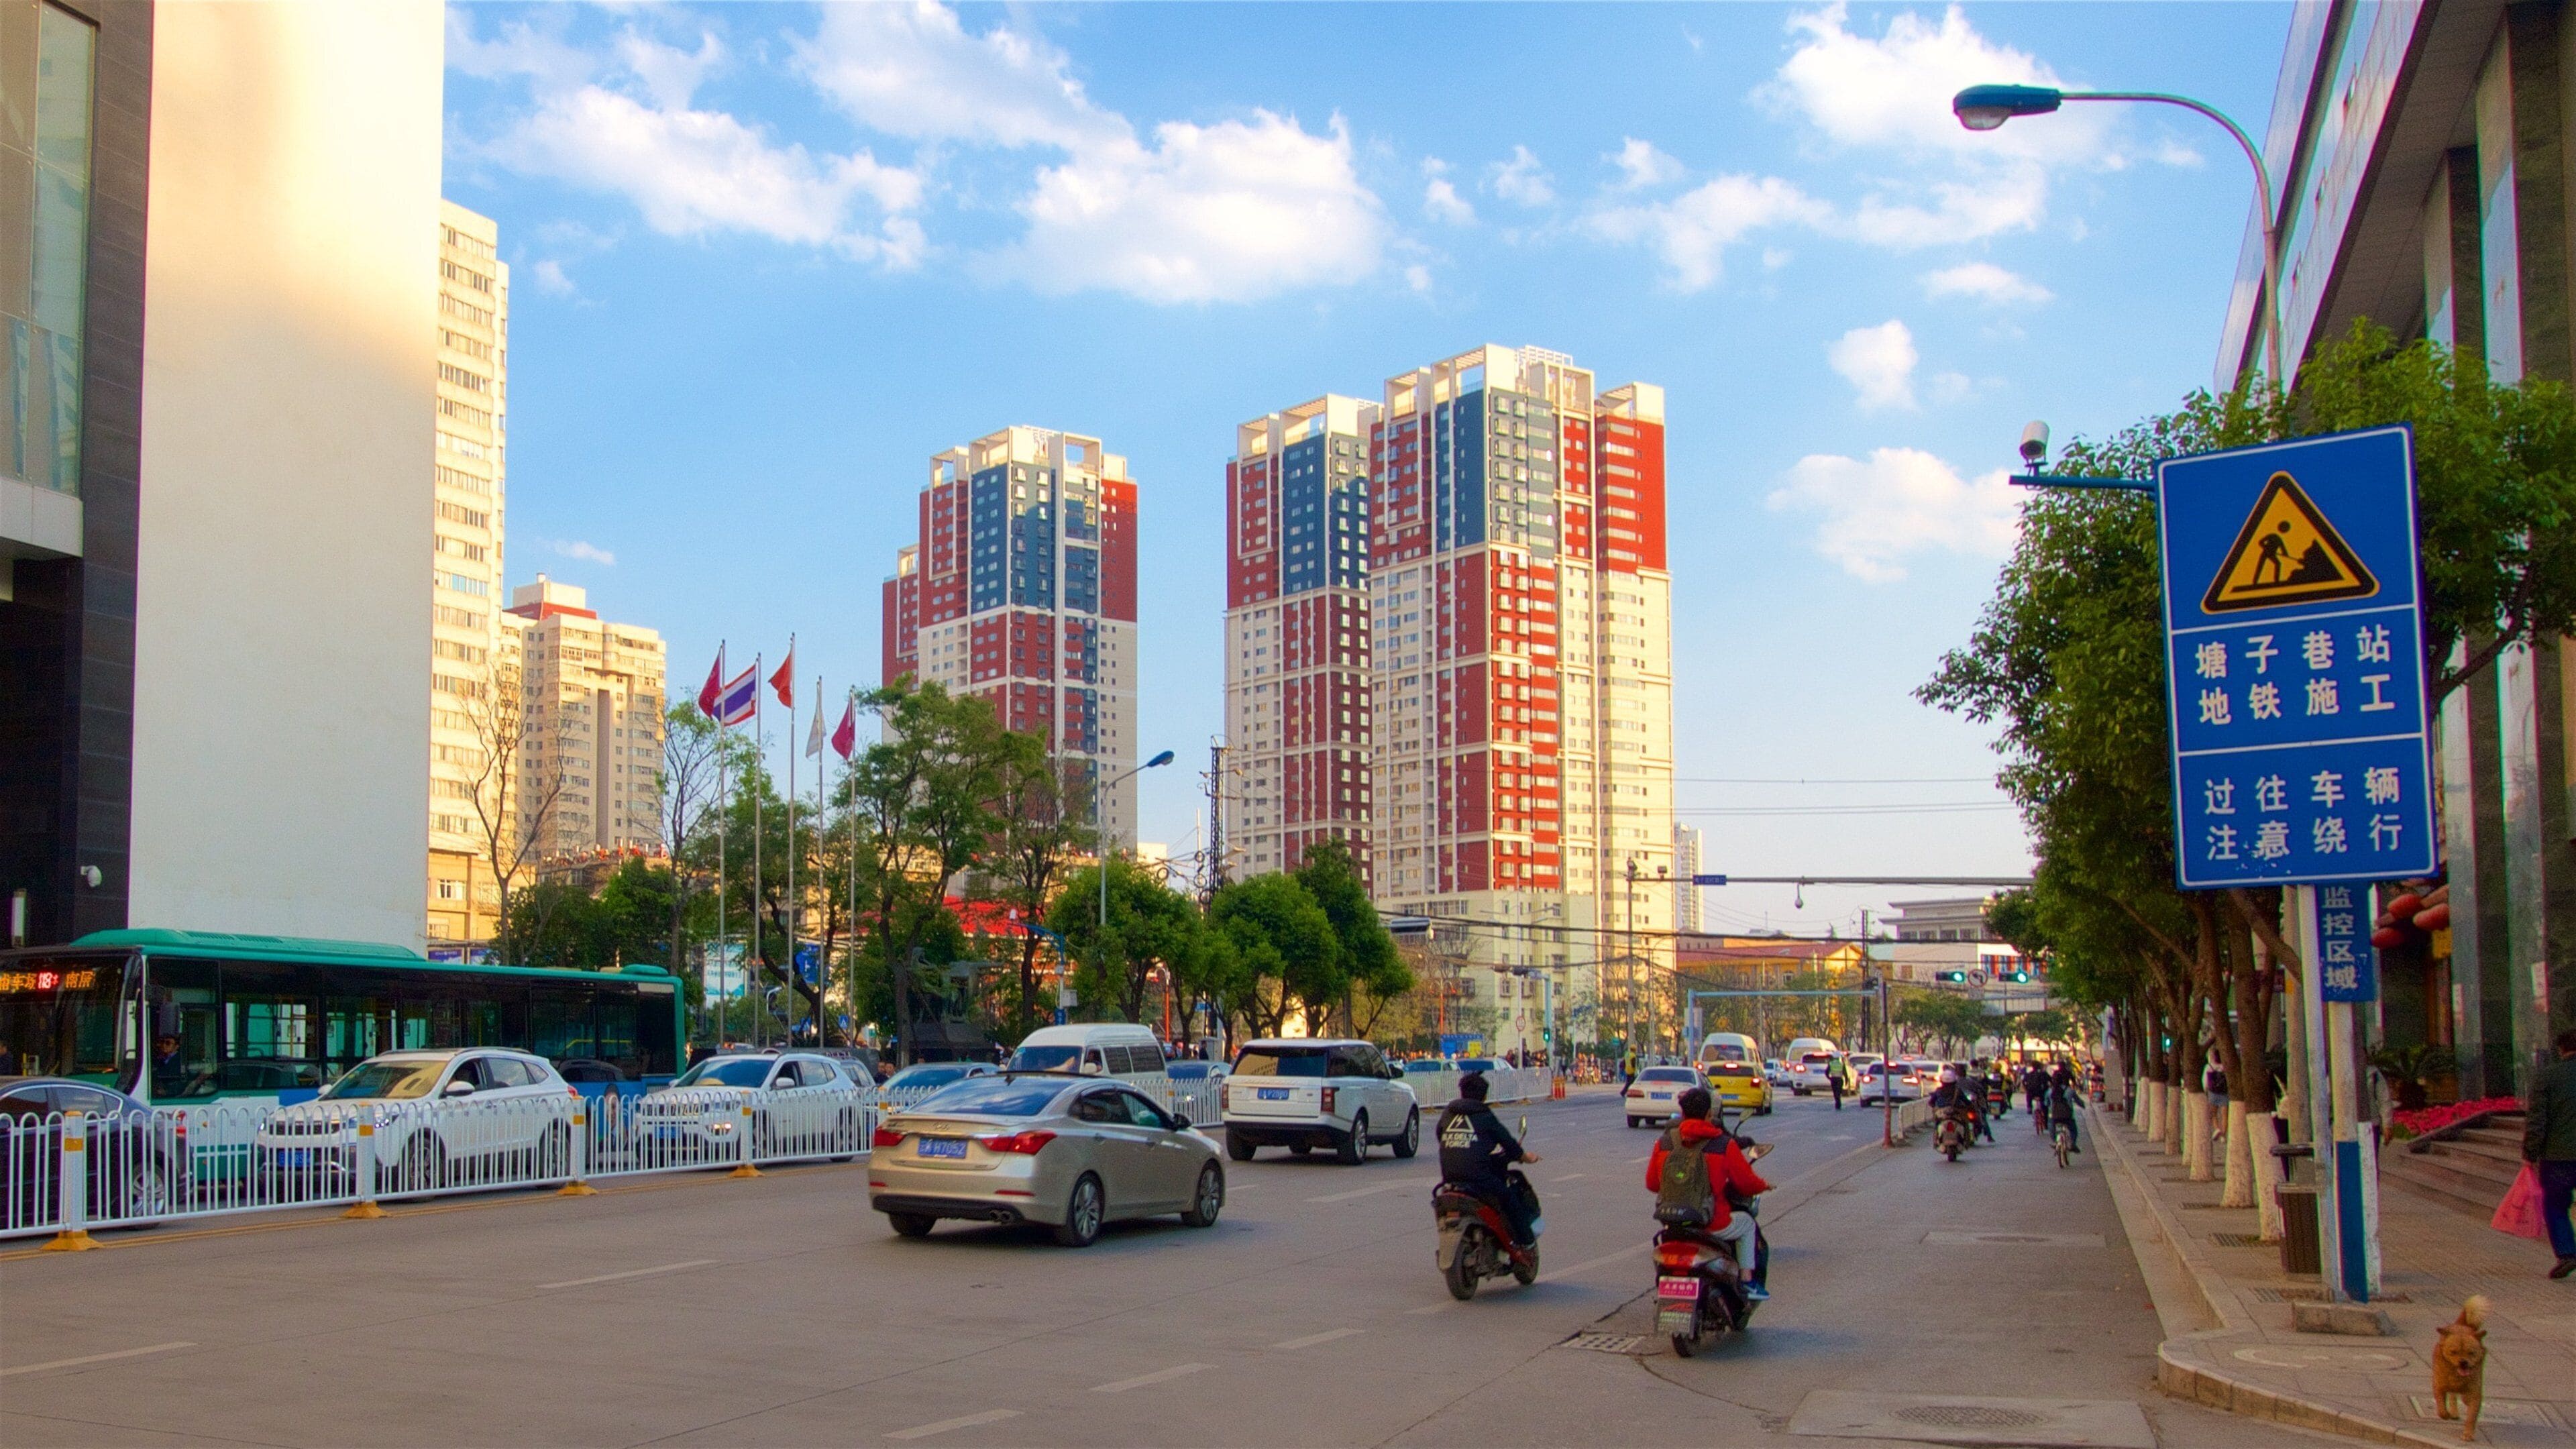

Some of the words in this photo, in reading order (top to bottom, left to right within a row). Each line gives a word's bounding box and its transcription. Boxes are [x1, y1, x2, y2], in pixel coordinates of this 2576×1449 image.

[2195, 624, 2391, 679] 塘子巷站
[2198, 673, 2396, 725] 地铁施工
[2204, 766, 2401, 814] 过往车辆
[2206, 813, 2404, 859] 注意绕行
[2322, 885, 2358, 989] 监控区域
